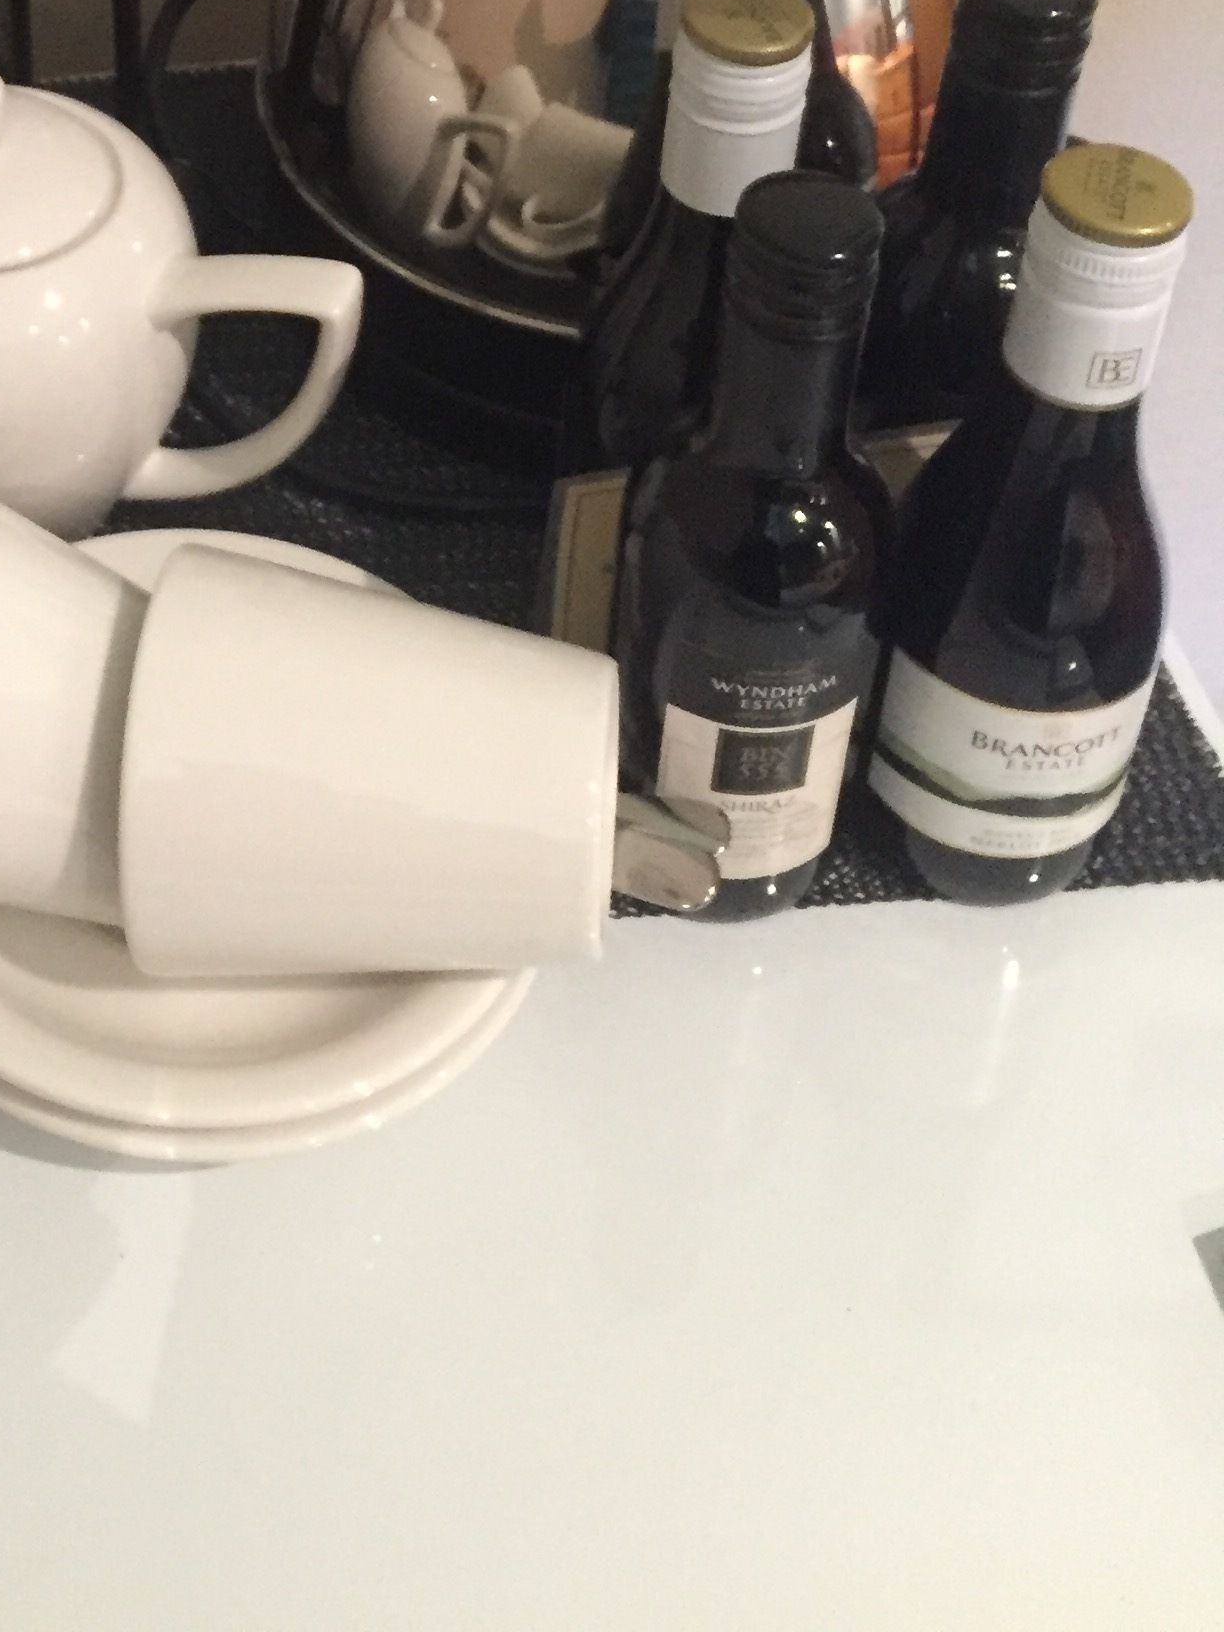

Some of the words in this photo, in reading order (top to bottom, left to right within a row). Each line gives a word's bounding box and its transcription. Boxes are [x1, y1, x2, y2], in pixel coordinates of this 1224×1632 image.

[712, 674, 837, 699] WYNDHAM
[741, 697, 807, 710] ESTATE
[971, 726, 1121, 757] BRANCOTT
[1005, 754, 1087, 770] ESTATE
